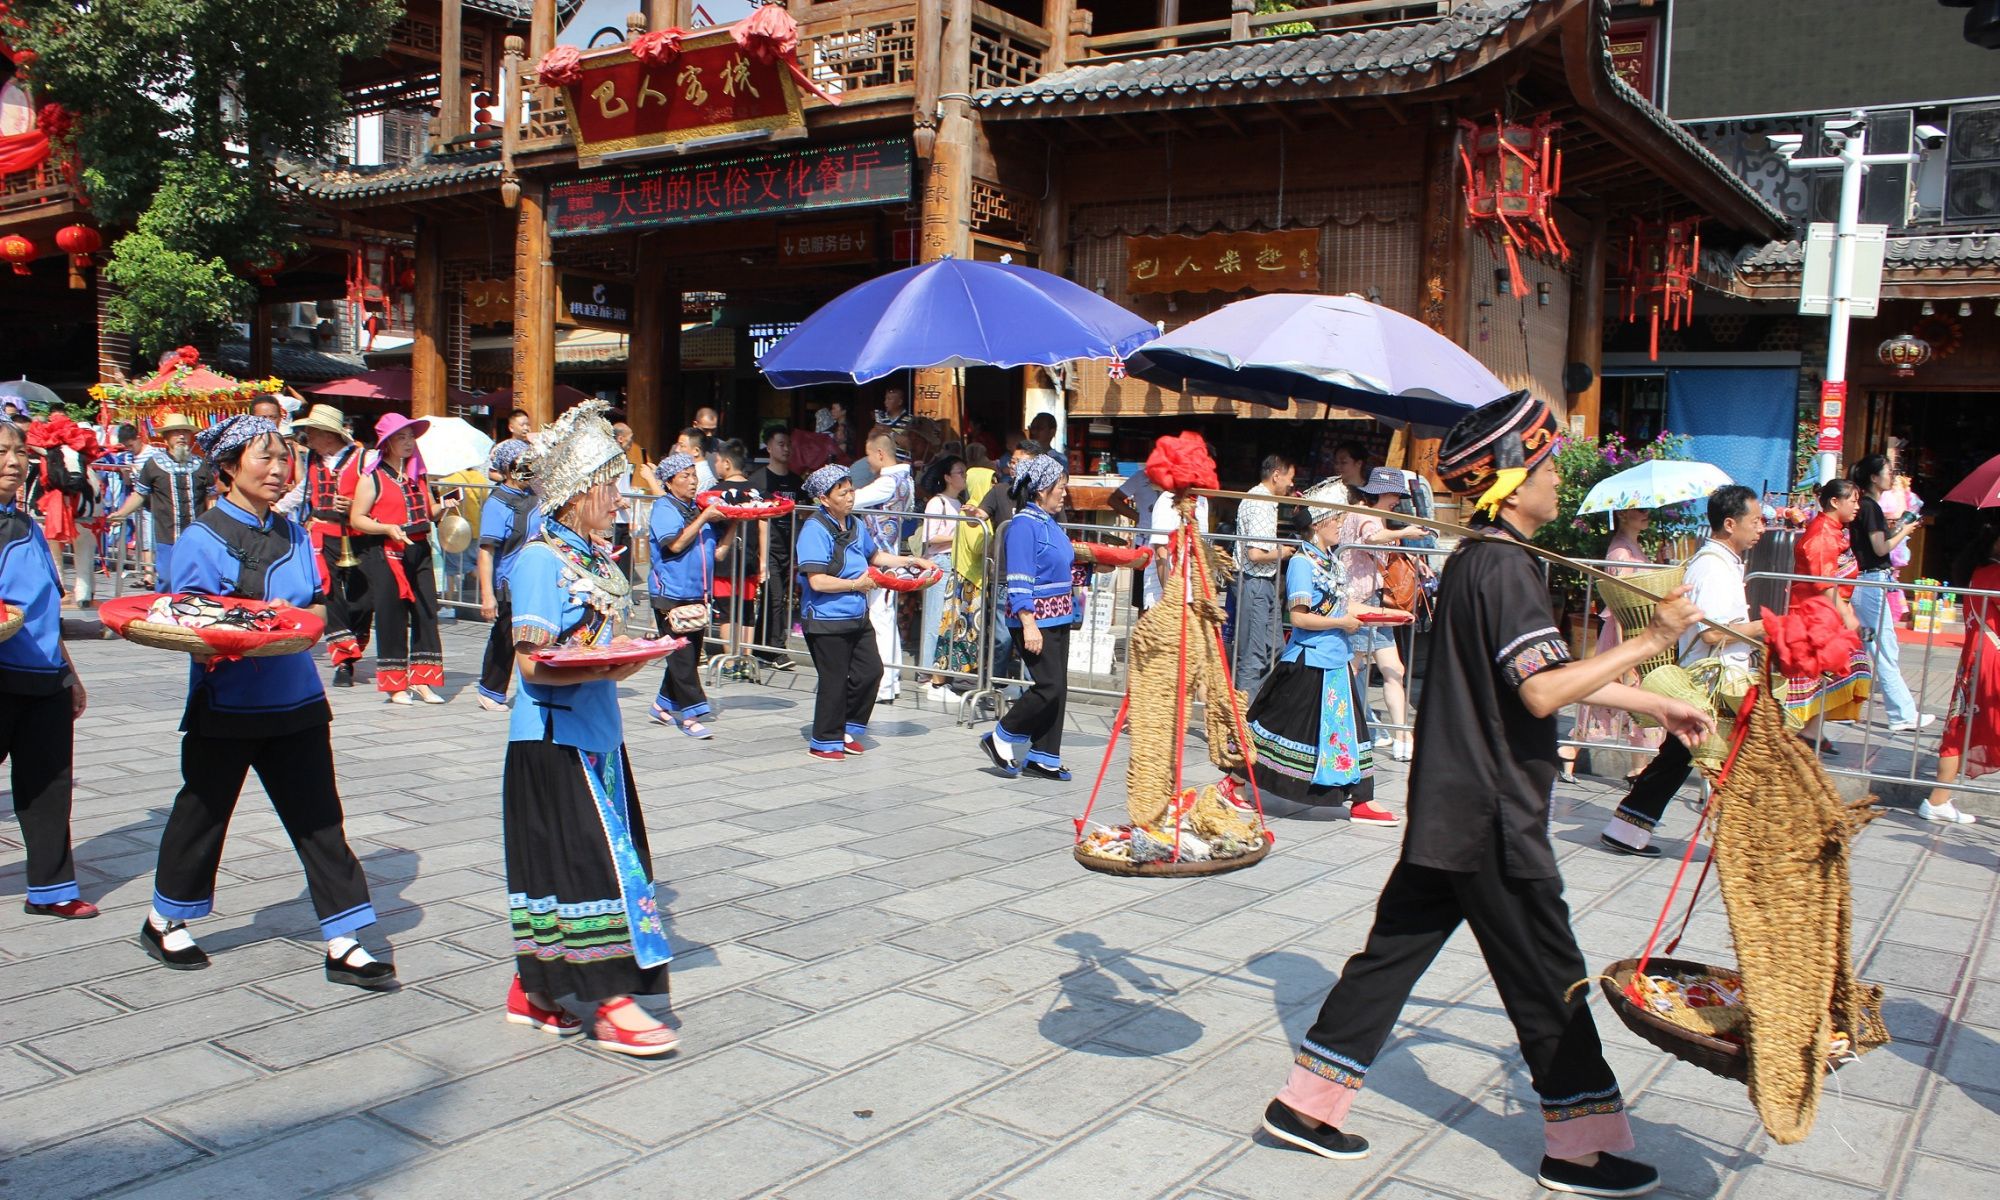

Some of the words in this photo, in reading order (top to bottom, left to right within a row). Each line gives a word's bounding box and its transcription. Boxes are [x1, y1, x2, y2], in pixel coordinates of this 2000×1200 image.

[798, 233, 852, 255] 总服务台
[569, 301, 628, 322] 携程旅游
